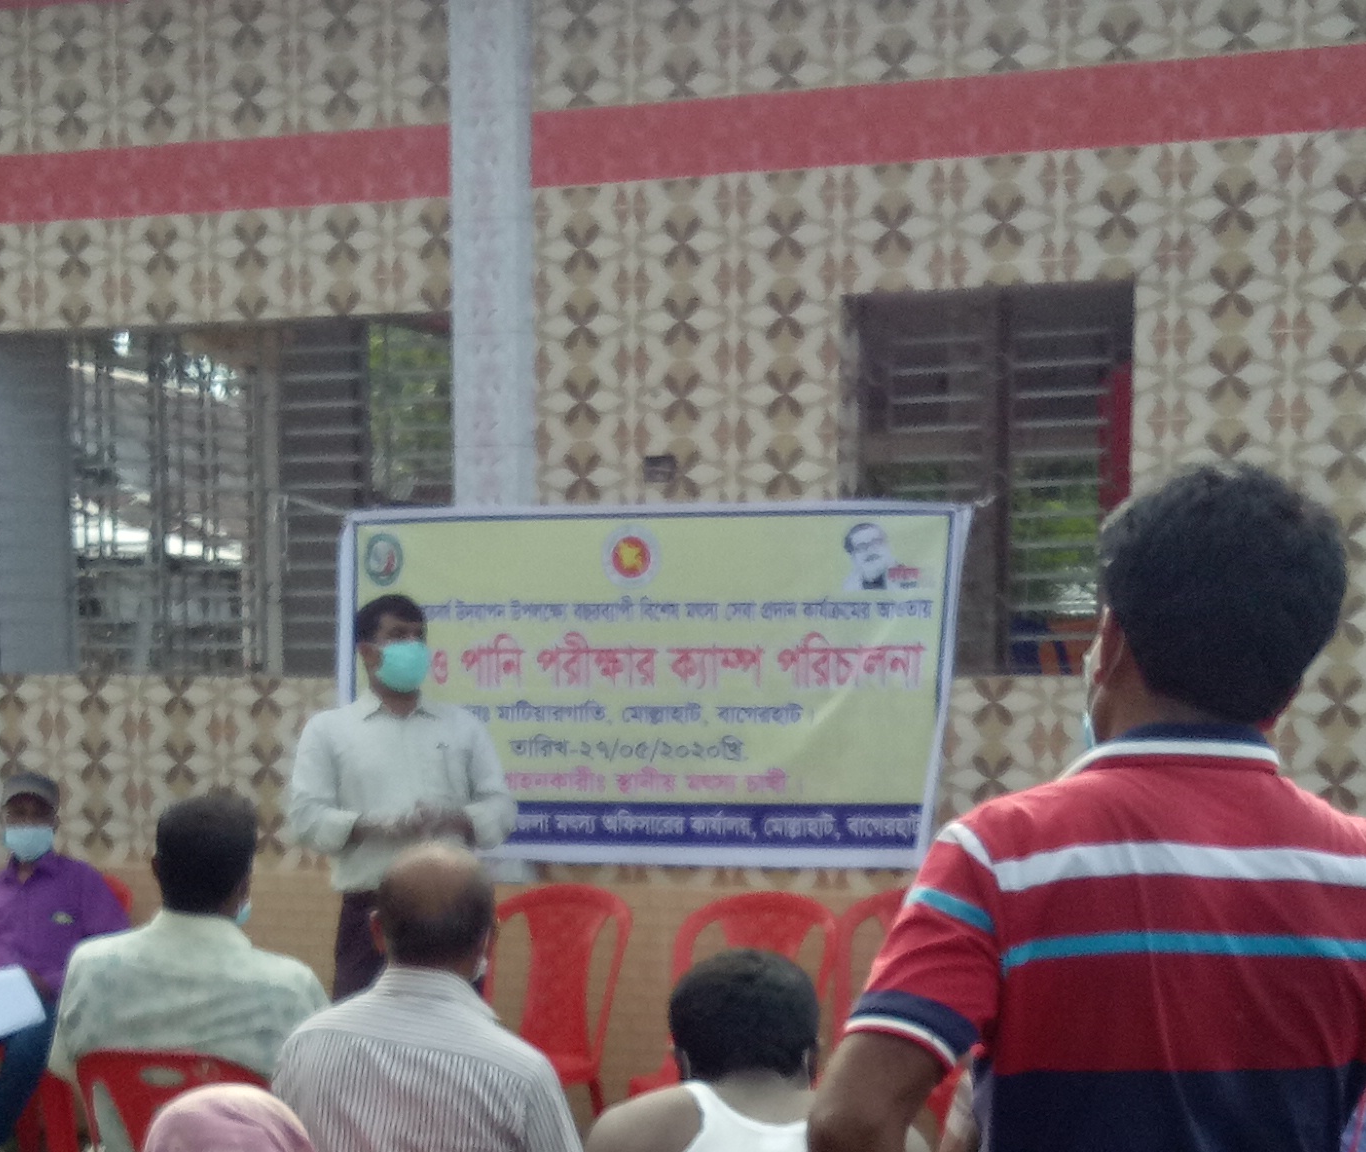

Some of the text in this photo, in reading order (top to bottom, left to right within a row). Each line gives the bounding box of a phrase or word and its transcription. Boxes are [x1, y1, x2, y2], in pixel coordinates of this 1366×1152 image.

[460, 633, 525, 688] পানি
[536, 631, 657, 688] পরীক্ষার
[668, 646, 763, 690] ক্যাম্প
[777, 631, 926, 688] পরিচালনা
